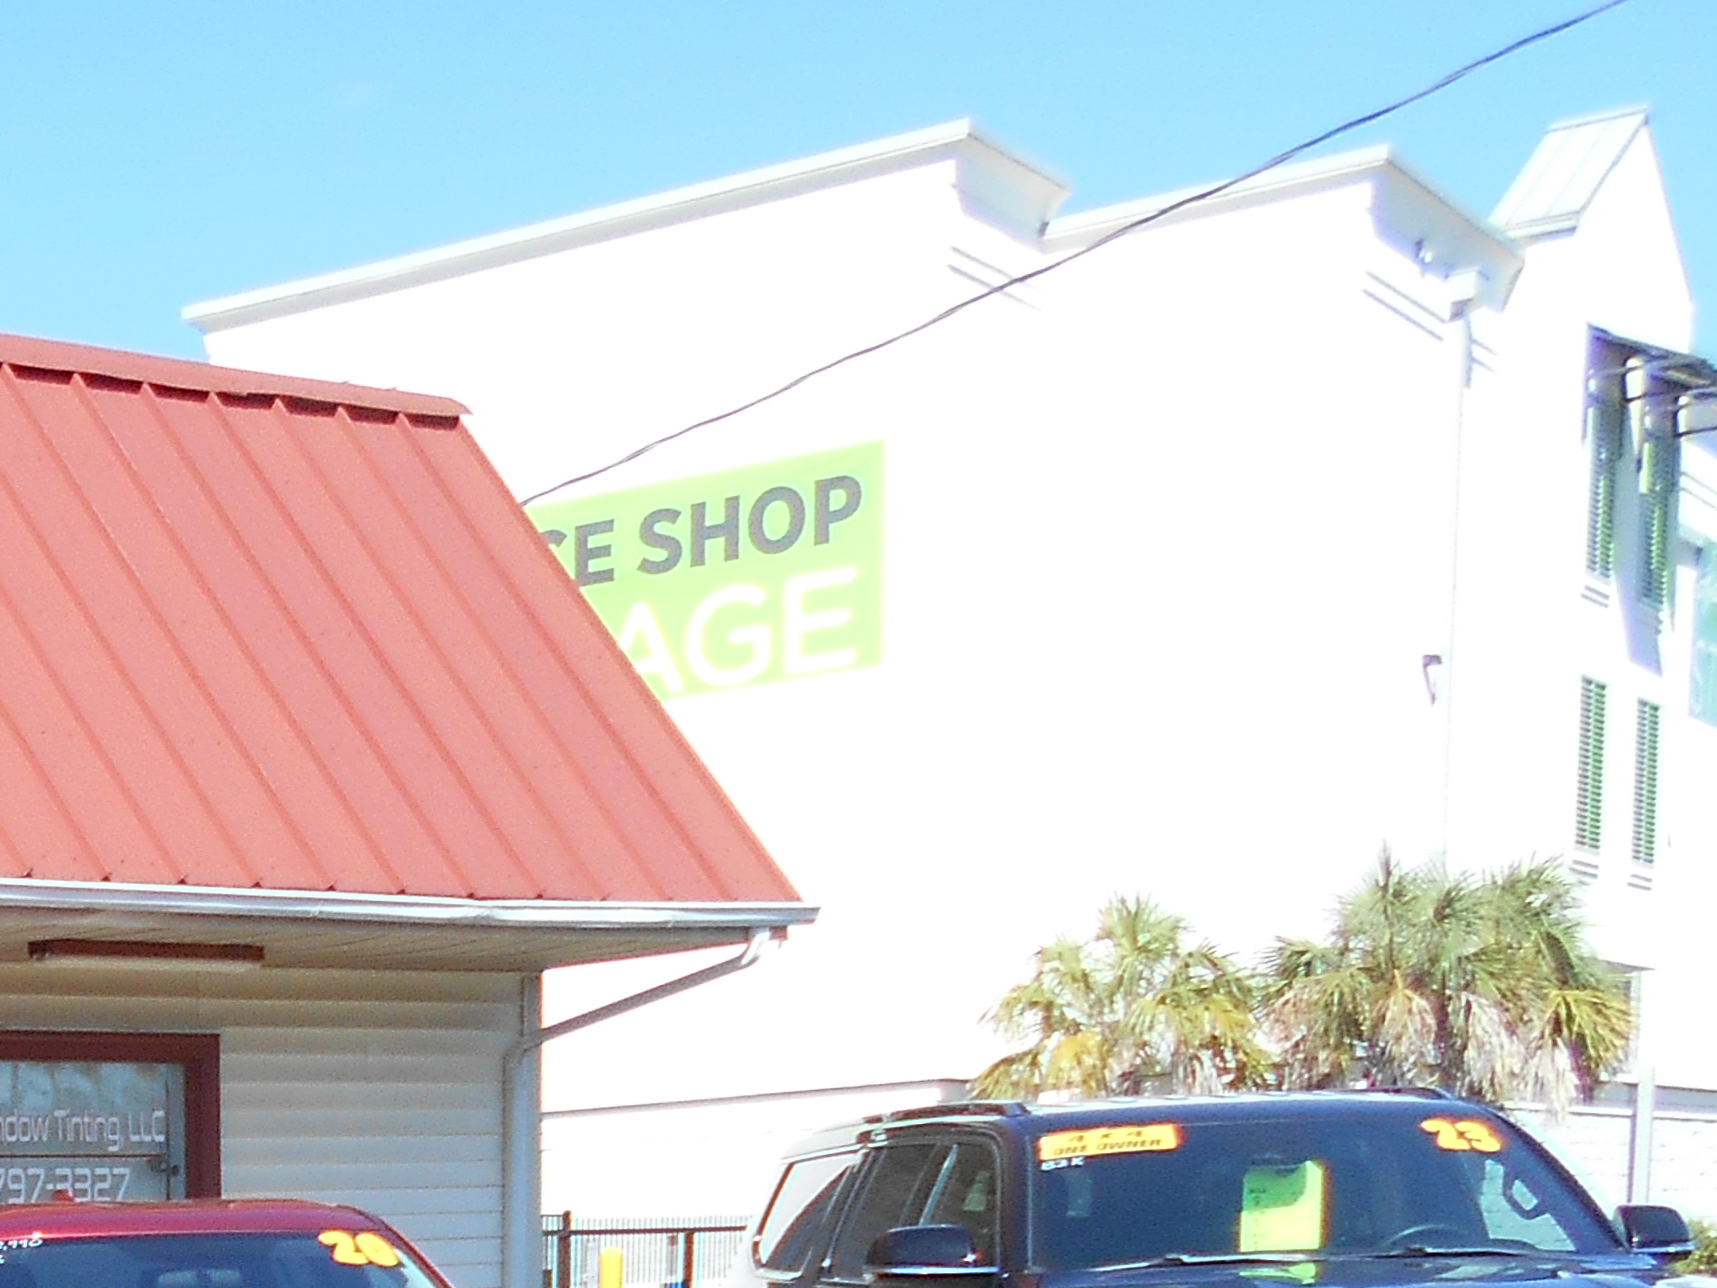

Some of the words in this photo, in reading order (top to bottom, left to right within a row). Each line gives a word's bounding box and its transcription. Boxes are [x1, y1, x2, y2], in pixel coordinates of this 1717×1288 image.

[637, 475, 862, 575] SHOP
[129, 1110, 165, 1142] LLC
[1420, 1119, 1500, 1152] 23
[317, 1230, 400, 1267] 20
